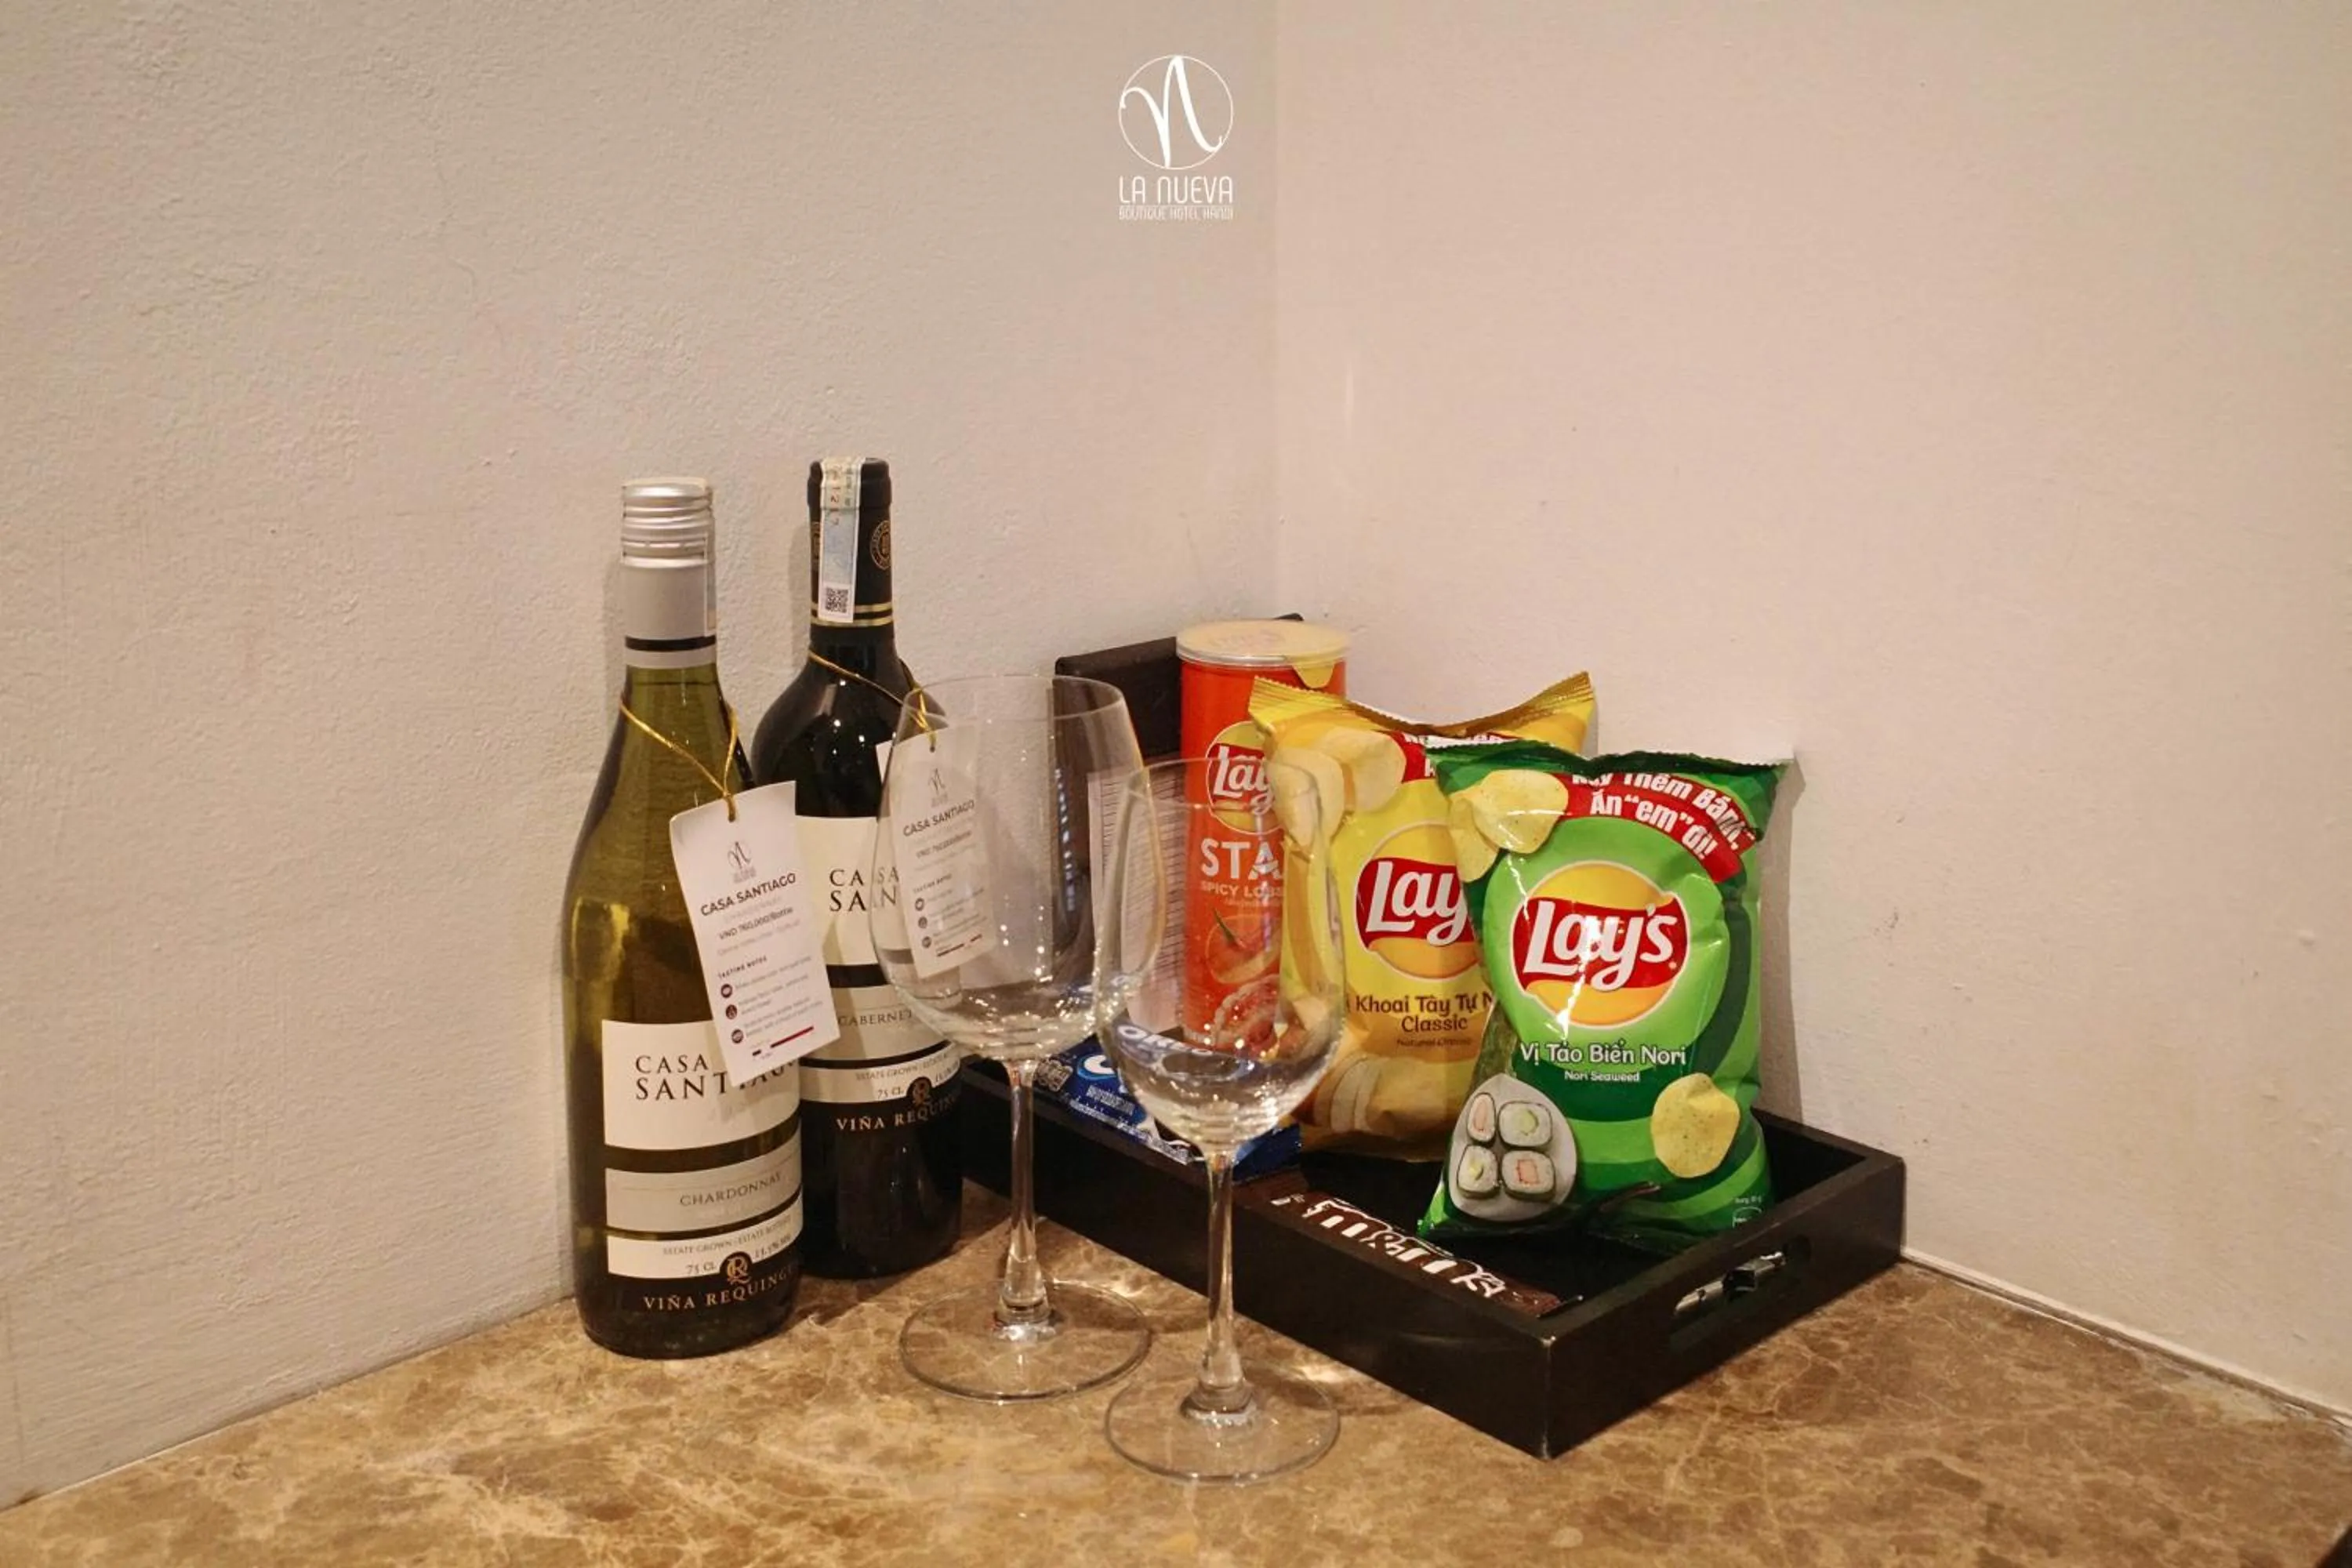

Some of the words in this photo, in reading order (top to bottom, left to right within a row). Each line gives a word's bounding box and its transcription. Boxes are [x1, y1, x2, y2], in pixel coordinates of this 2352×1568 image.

[1213, 745, 1273, 815] Lay
[903, 818, 931, 837] CASA
[932, 799, 975, 826] SANTIAGO
[829, 866, 899, 887] CASA
[1201, 837, 1283, 880] STA
[700, 896, 735, 916] CASA
[735, 873, 797, 903] SANTIAGO
[1201, 880, 1239, 895] SPICY
[1366, 861, 1468, 946] Lay
[1523, 900, 1678, 991] Lay's
[1356, 995, 1409, 1013] Khoai
[1401, 1014, 1468, 1033] Classic
[635, 1053, 709, 1074] CASA
[1520, 1043, 1540, 1066] Vị
[1546, 1041, 1582, 1062] Tảo
[1589, 1038, 1635, 1064] Biển
[1641, 1047, 1686, 1065] Nori
[636, 1060, 796, 1101] SANT
[1564, 1071, 1588, 1080] Nori
[1590, 1072, 1639, 1082] Seaweed
[836, 1116, 885, 1131] VIÑA
[680, 1171, 782, 1207] CHARDONNAY
[643, 1294, 696, 1311] VIÑA
[706, 1265, 795, 1307] REQUING
